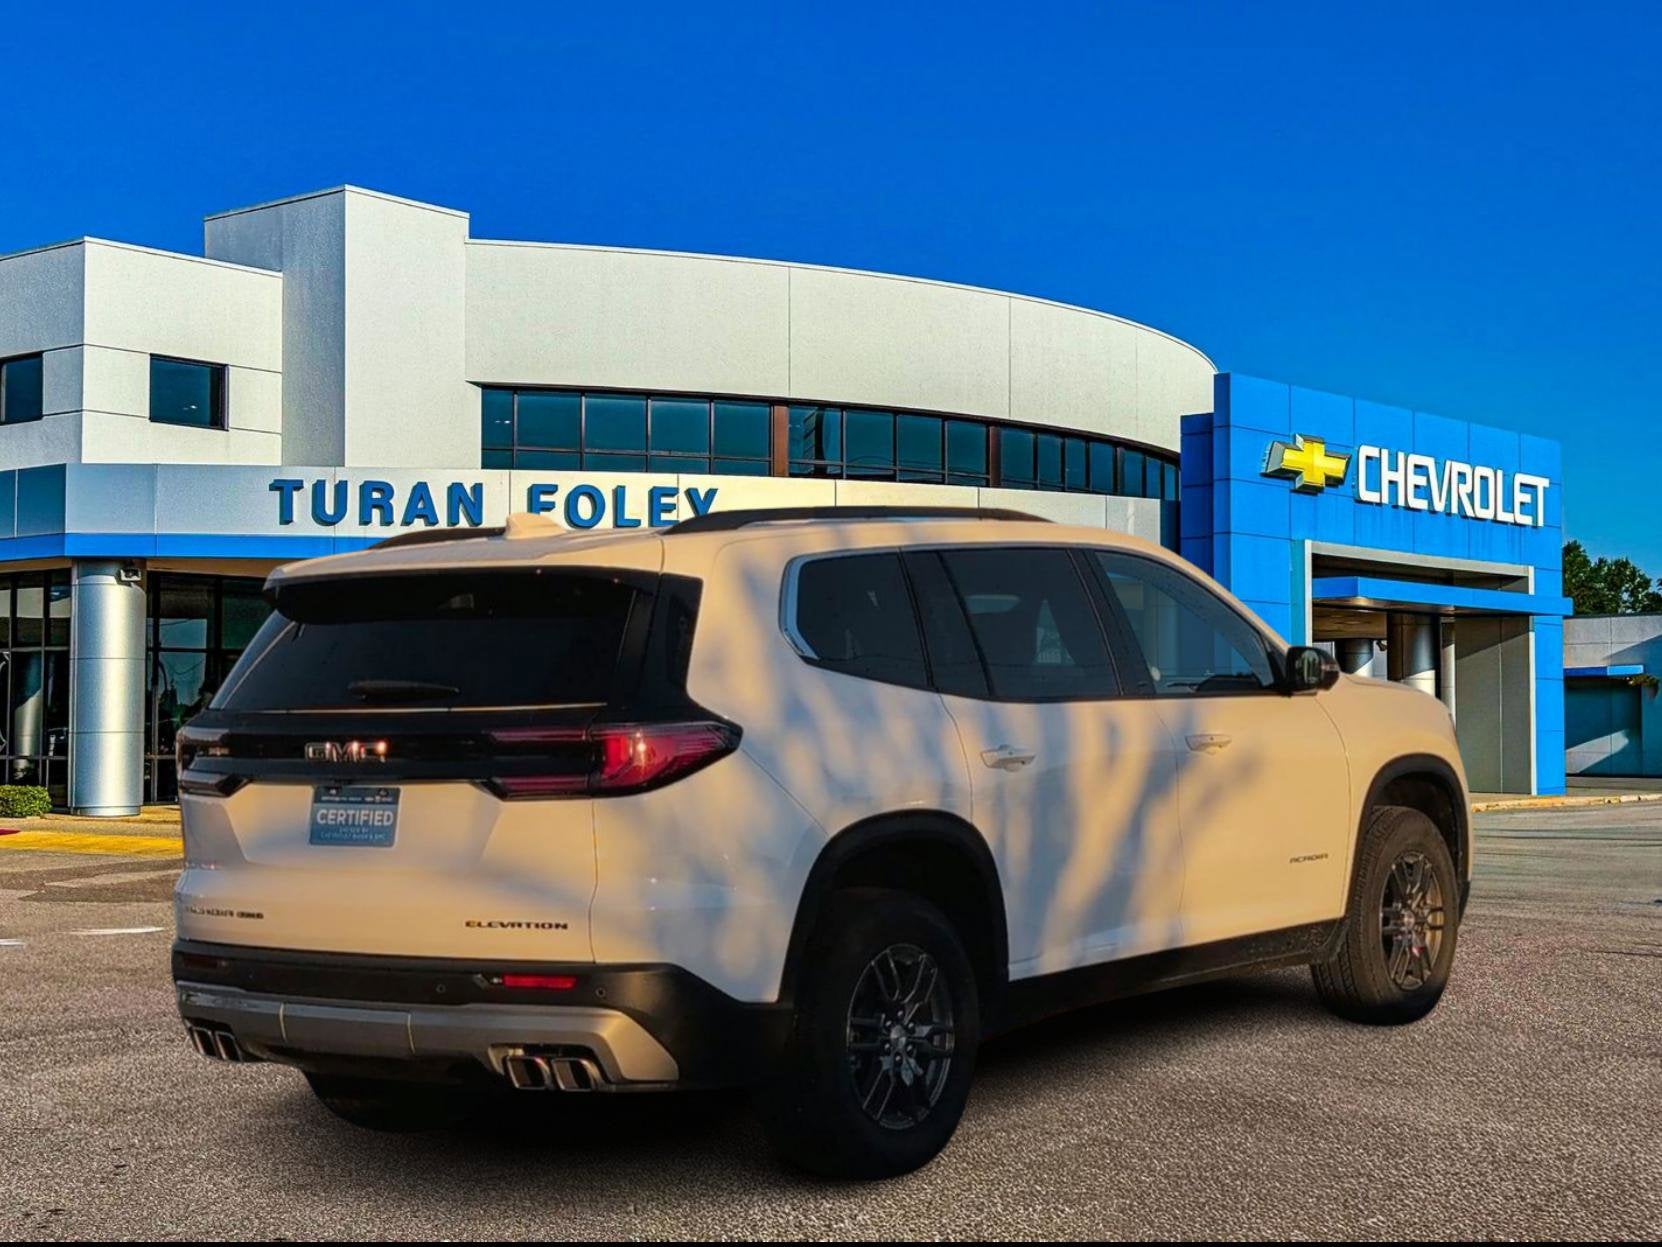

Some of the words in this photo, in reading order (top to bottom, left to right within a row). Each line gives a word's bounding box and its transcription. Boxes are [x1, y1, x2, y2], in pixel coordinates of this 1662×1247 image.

[1357, 444, 1550, 527] CHEVROLET
[268, 478, 484, 527] TURAN
[526, 483, 719, 529] FOLEY
[304, 741, 388, 763] GMC
[316, 808, 394, 826] CERTIFIED
[464, 920, 569, 931] ELEVATION
